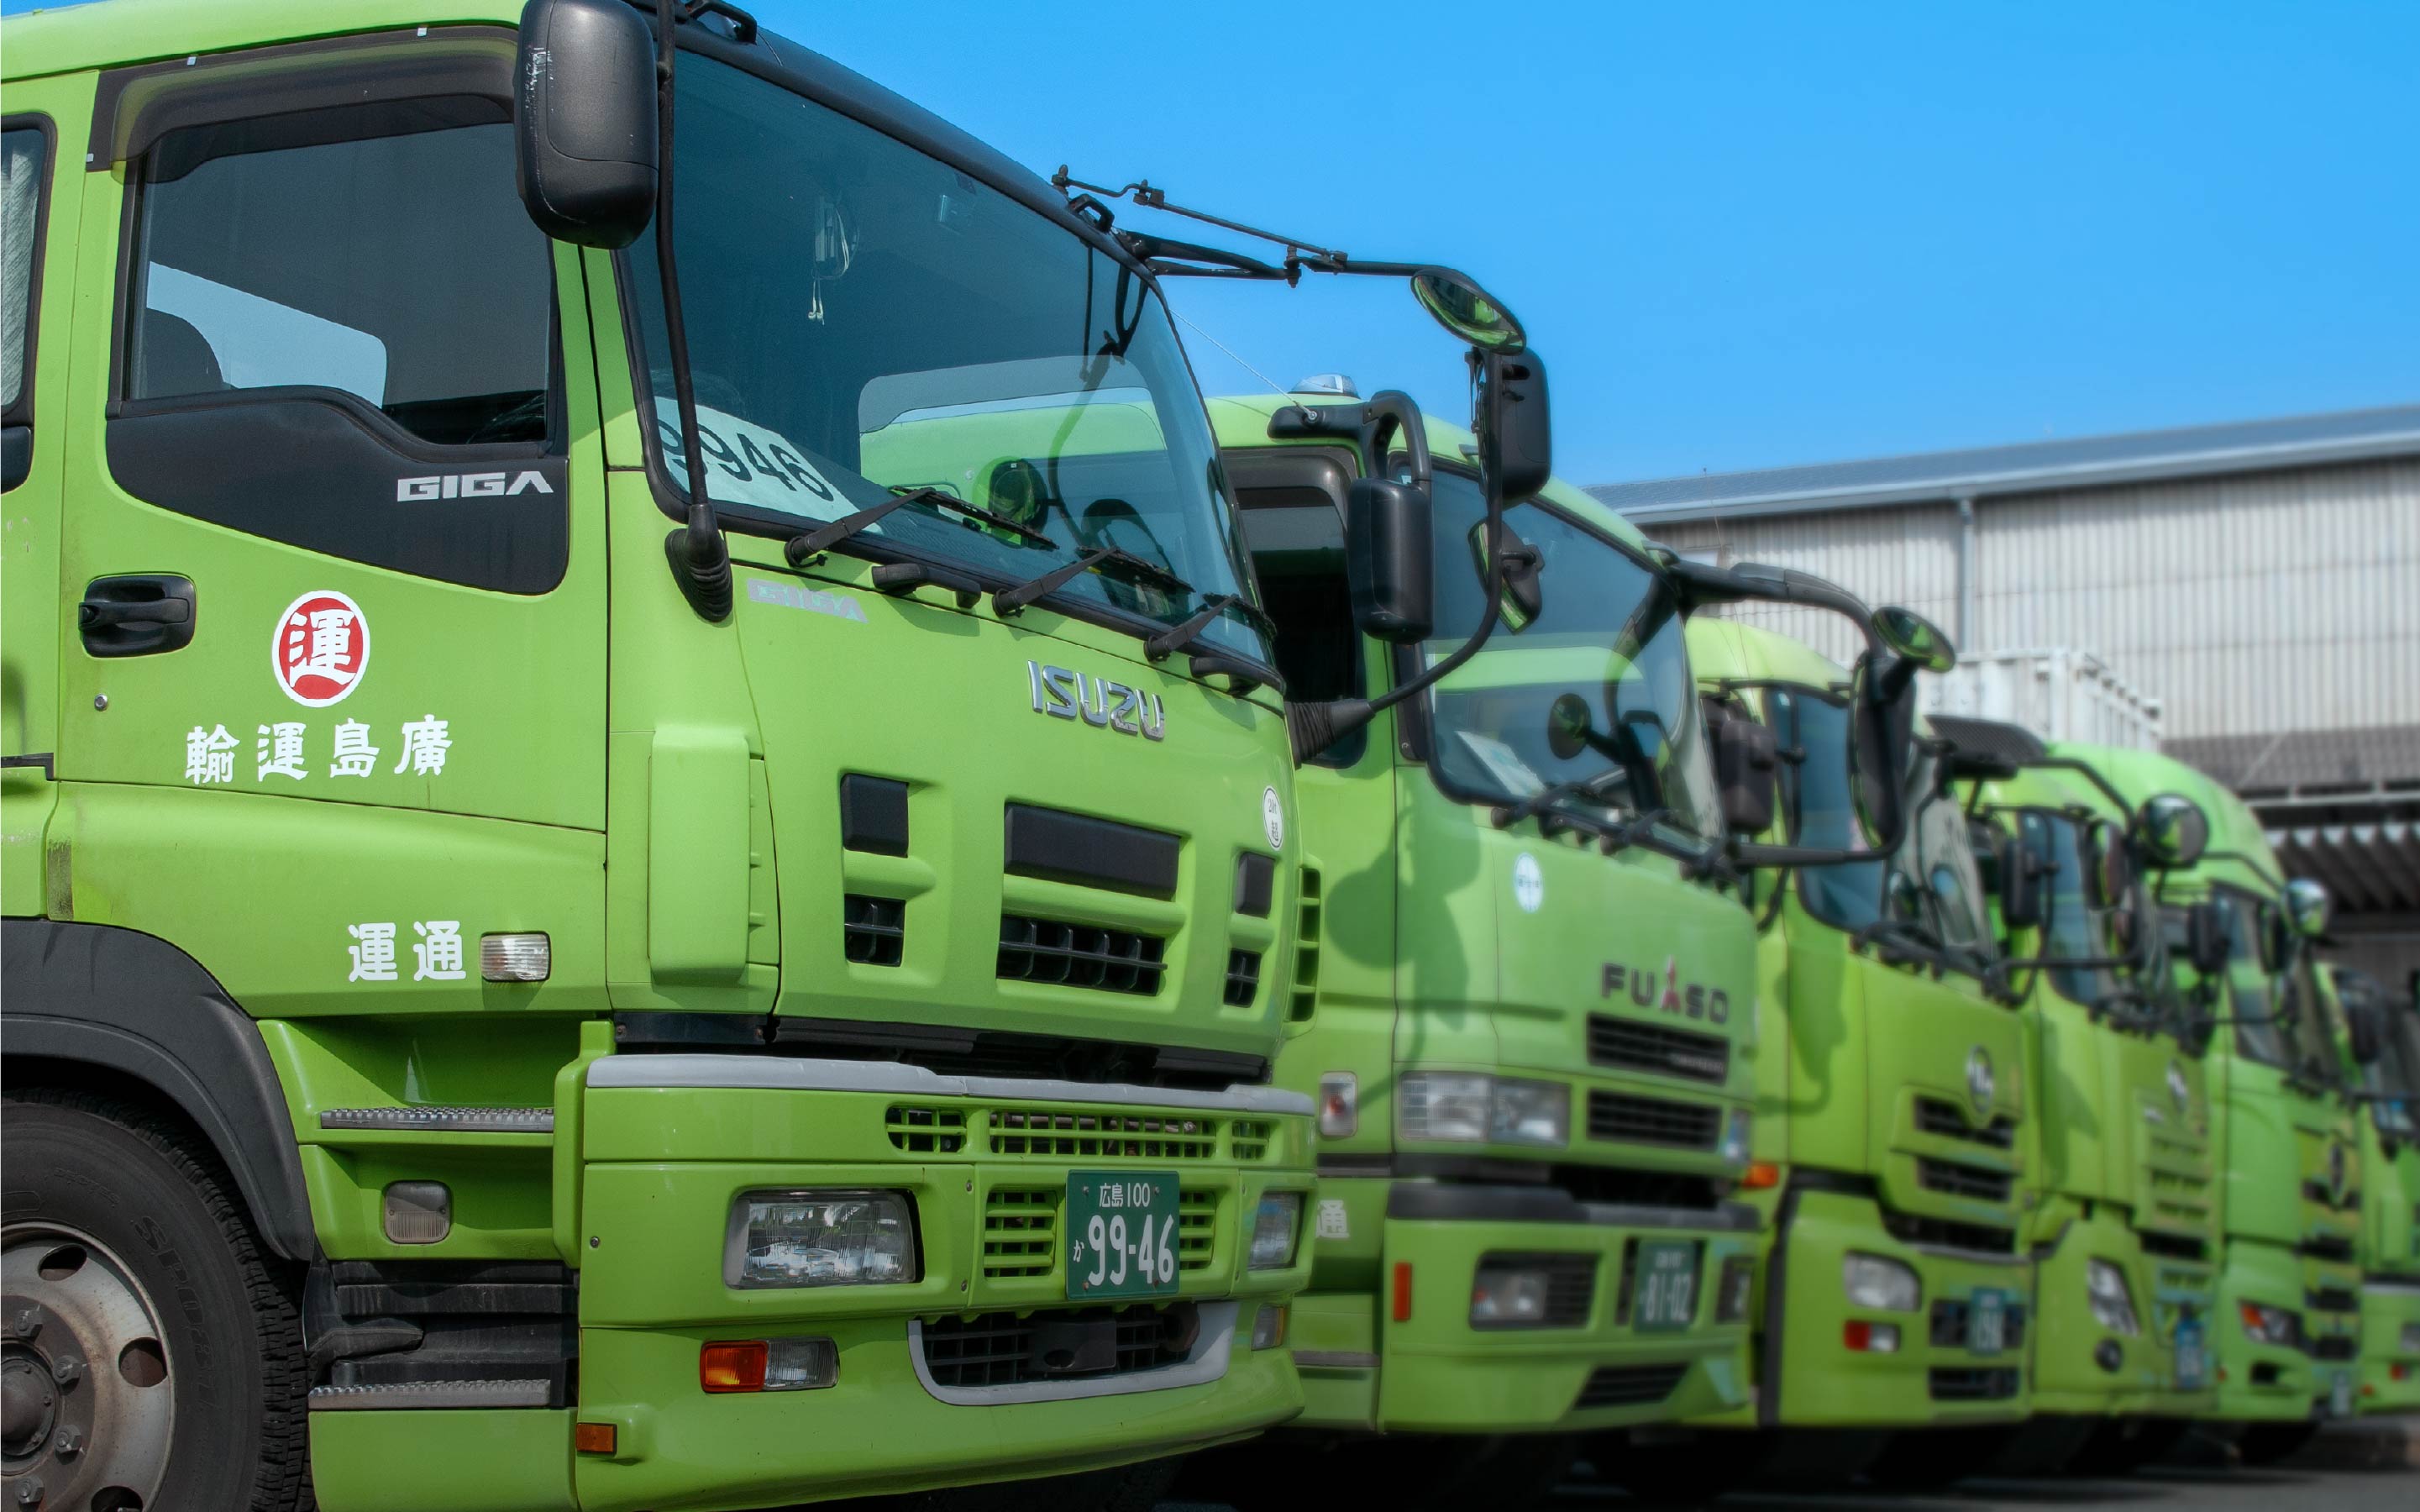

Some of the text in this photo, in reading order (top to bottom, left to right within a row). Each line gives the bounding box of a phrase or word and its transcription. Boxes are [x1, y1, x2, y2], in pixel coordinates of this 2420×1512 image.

[396, 470, 554, 502] GIGA
[747, 578, 869, 624] GIGA
[1027, 660, 1166, 742] ISUZU
[1601, 961, 1729, 1026] FUSO
[1088, 1214, 1174, 1286] 99-46
